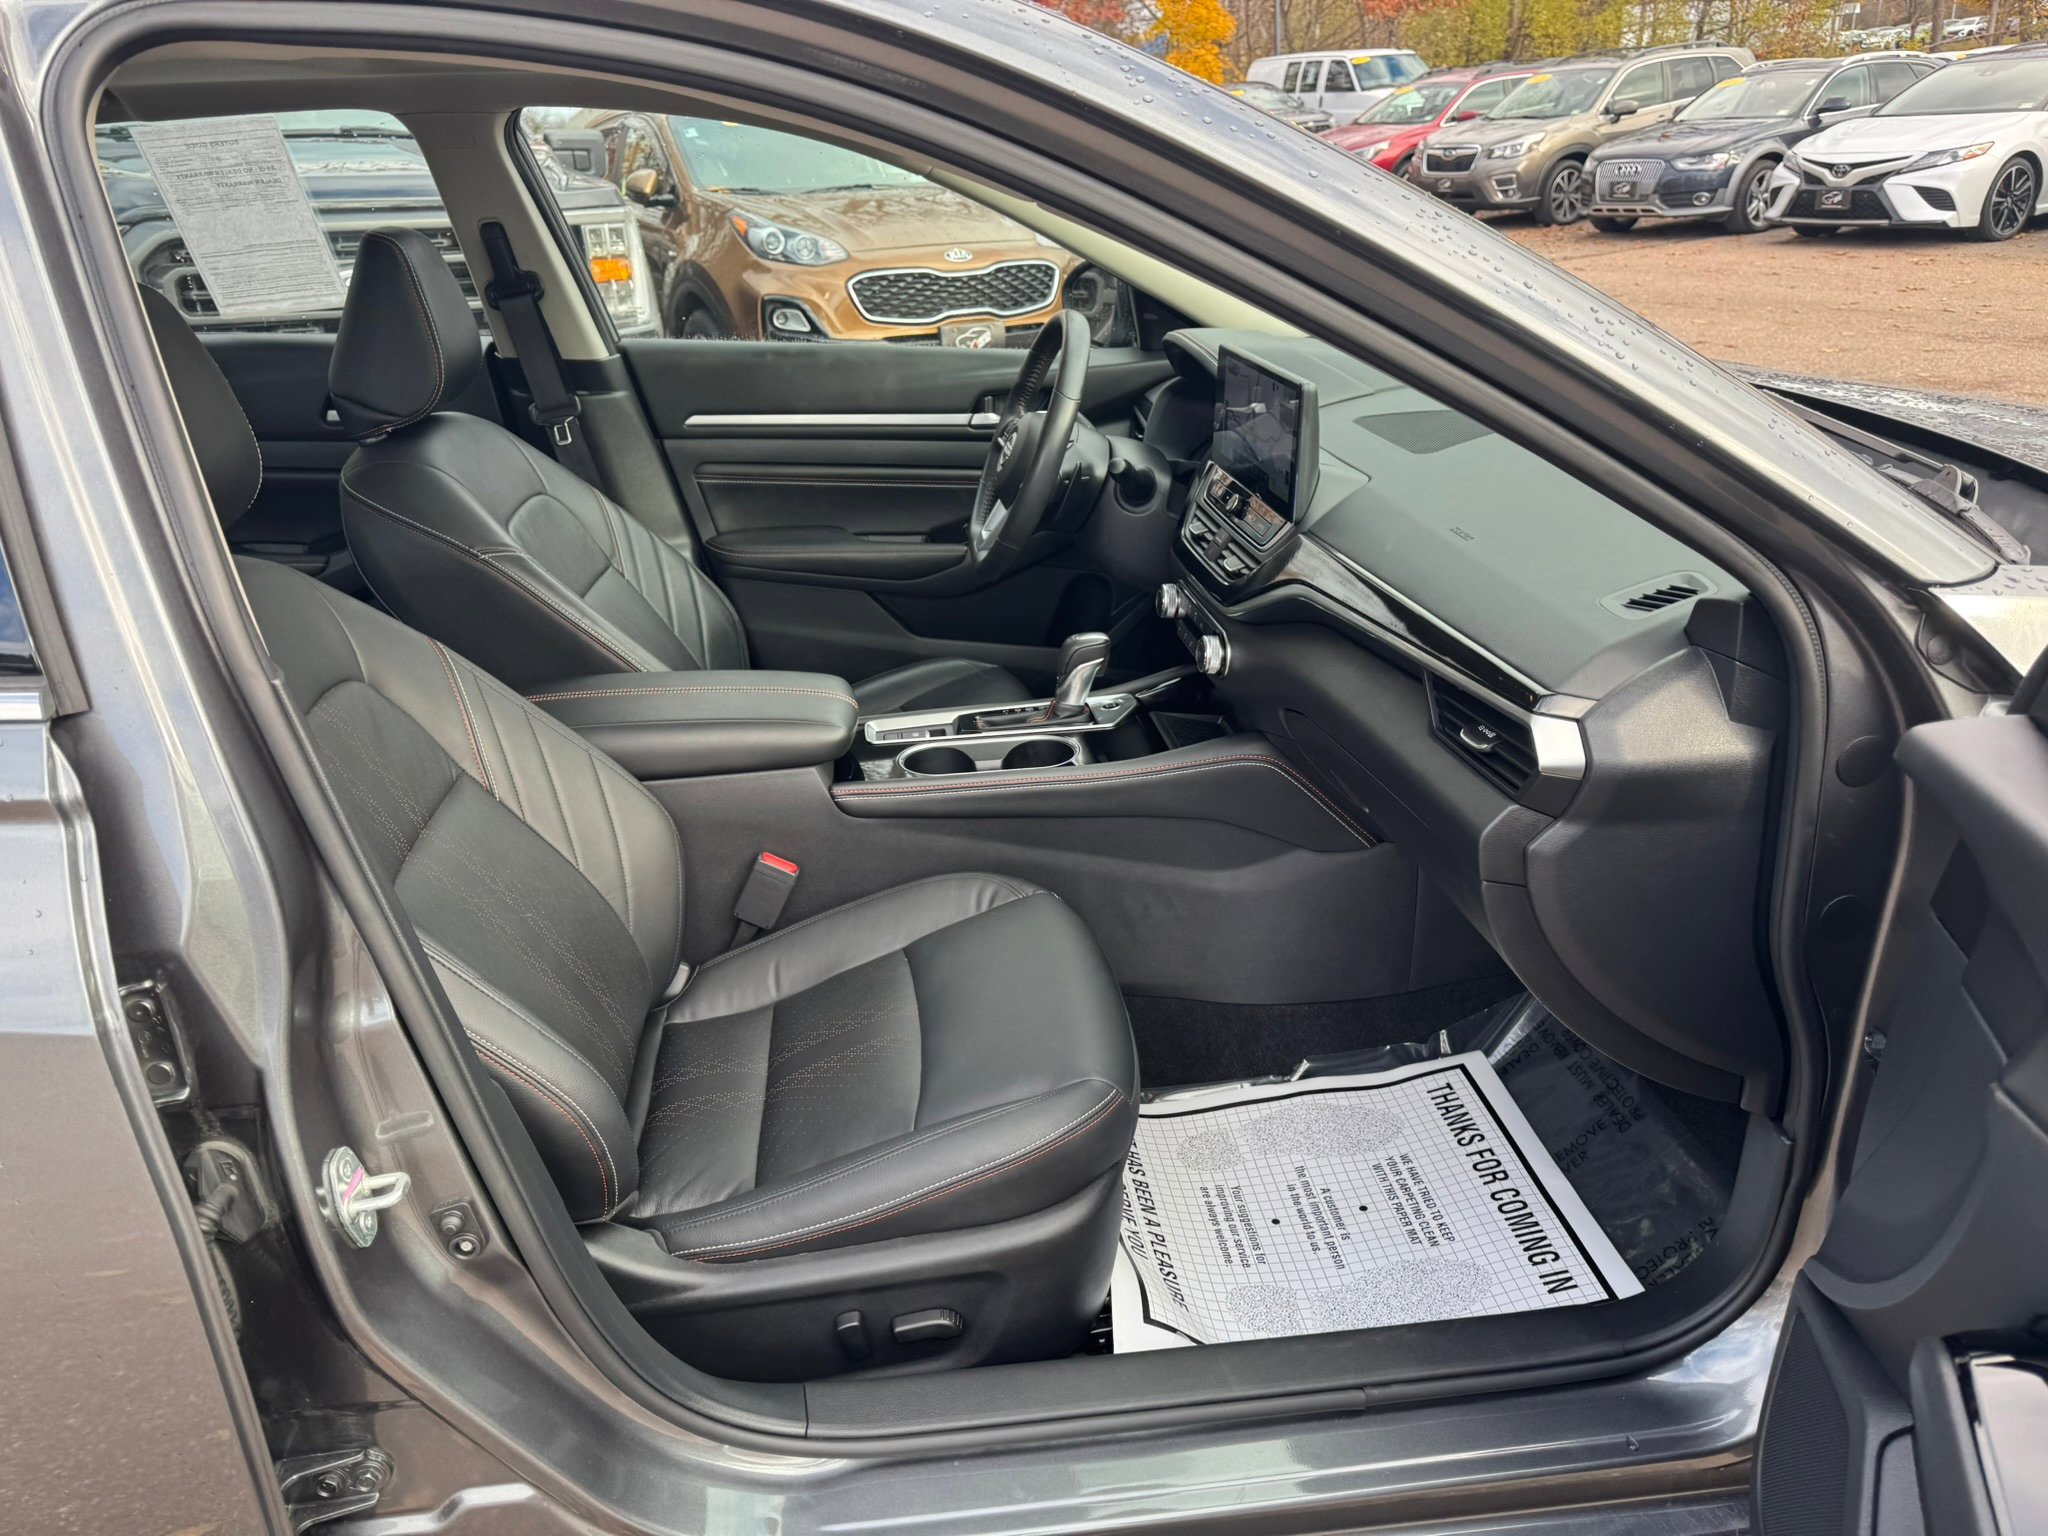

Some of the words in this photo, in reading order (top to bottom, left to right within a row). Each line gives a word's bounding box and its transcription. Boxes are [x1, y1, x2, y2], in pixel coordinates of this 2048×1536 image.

[1567, 1061, 1595, 1090] MUST
[1588, 1058, 1647, 1122] PROTECTIVE
[1593, 1091, 1632, 1133] DEALER
[1127, 1150, 1146, 1177] HAS
[1295, 1165, 1307, 1178] the
[1400, 1153, 1413, 1166] WE
[1286, 1183, 1297, 1192] in
[1406, 1166, 1424, 1186] HAVE
[1427, 1082, 1485, 1147] THANKS
[1465, 1147, 1509, 1186] FOR
[1490, 1187, 1560, 1267] COMING
[1539, 1269, 1578, 1295] IN
[1132, 1178, 1158, 1217] BEEN
[1200, 1186, 1211, 1199] are
[1214, 1184, 1235, 1222] improving
[1231, 1185, 1244, 1203] Your
[1290, 1193, 1302, 1206] the
[1300, 1180, 1317, 1200] most
[1384, 1156, 1403, 1177] YOUR
[1395, 1178, 1426, 1220] CARPETING
[1418, 1221, 1441, 1247] CLEAN
[1417, 1186, 1436, 1209] TRIED
[1204, 1200, 1220, 1227] always
[1372, 1163, 1391, 1183] WITH
[1382, 1183, 1399, 1201] THIS
[1391, 1201, 1413, 1228] PAPER
[1405, 1228, 1423, 1245] MAT
[1430, 1209, 1444, 1221] TO
[1143, 1216, 1161, 1228] A
[1228, 1223, 1240, 1237] our
[1237, 1204, 1261, 1252] suggestions
[1296, 1208, 1314, 1230] world
[1309, 1201, 1335, 1241] important
[1323, 1196, 1346, 1231] customer
[1340, 1232, 1351, 1241] is
[1436, 1222, 1456, 1242] KEEP
[1125, 1228, 1149, 1260] YOU
[1214, 1228, 1233, 1267] welcome.
[1305, 1231, 1316, 1240] to
[1309, 1242, 1321, 1255] us.
[1233, 1238, 1251, 1269] service
[1254, 1253, 1267, 1265] for
[1324, 1240, 1345, 1270] person
[1148, 1230, 1189, 1312] PLEASURE
